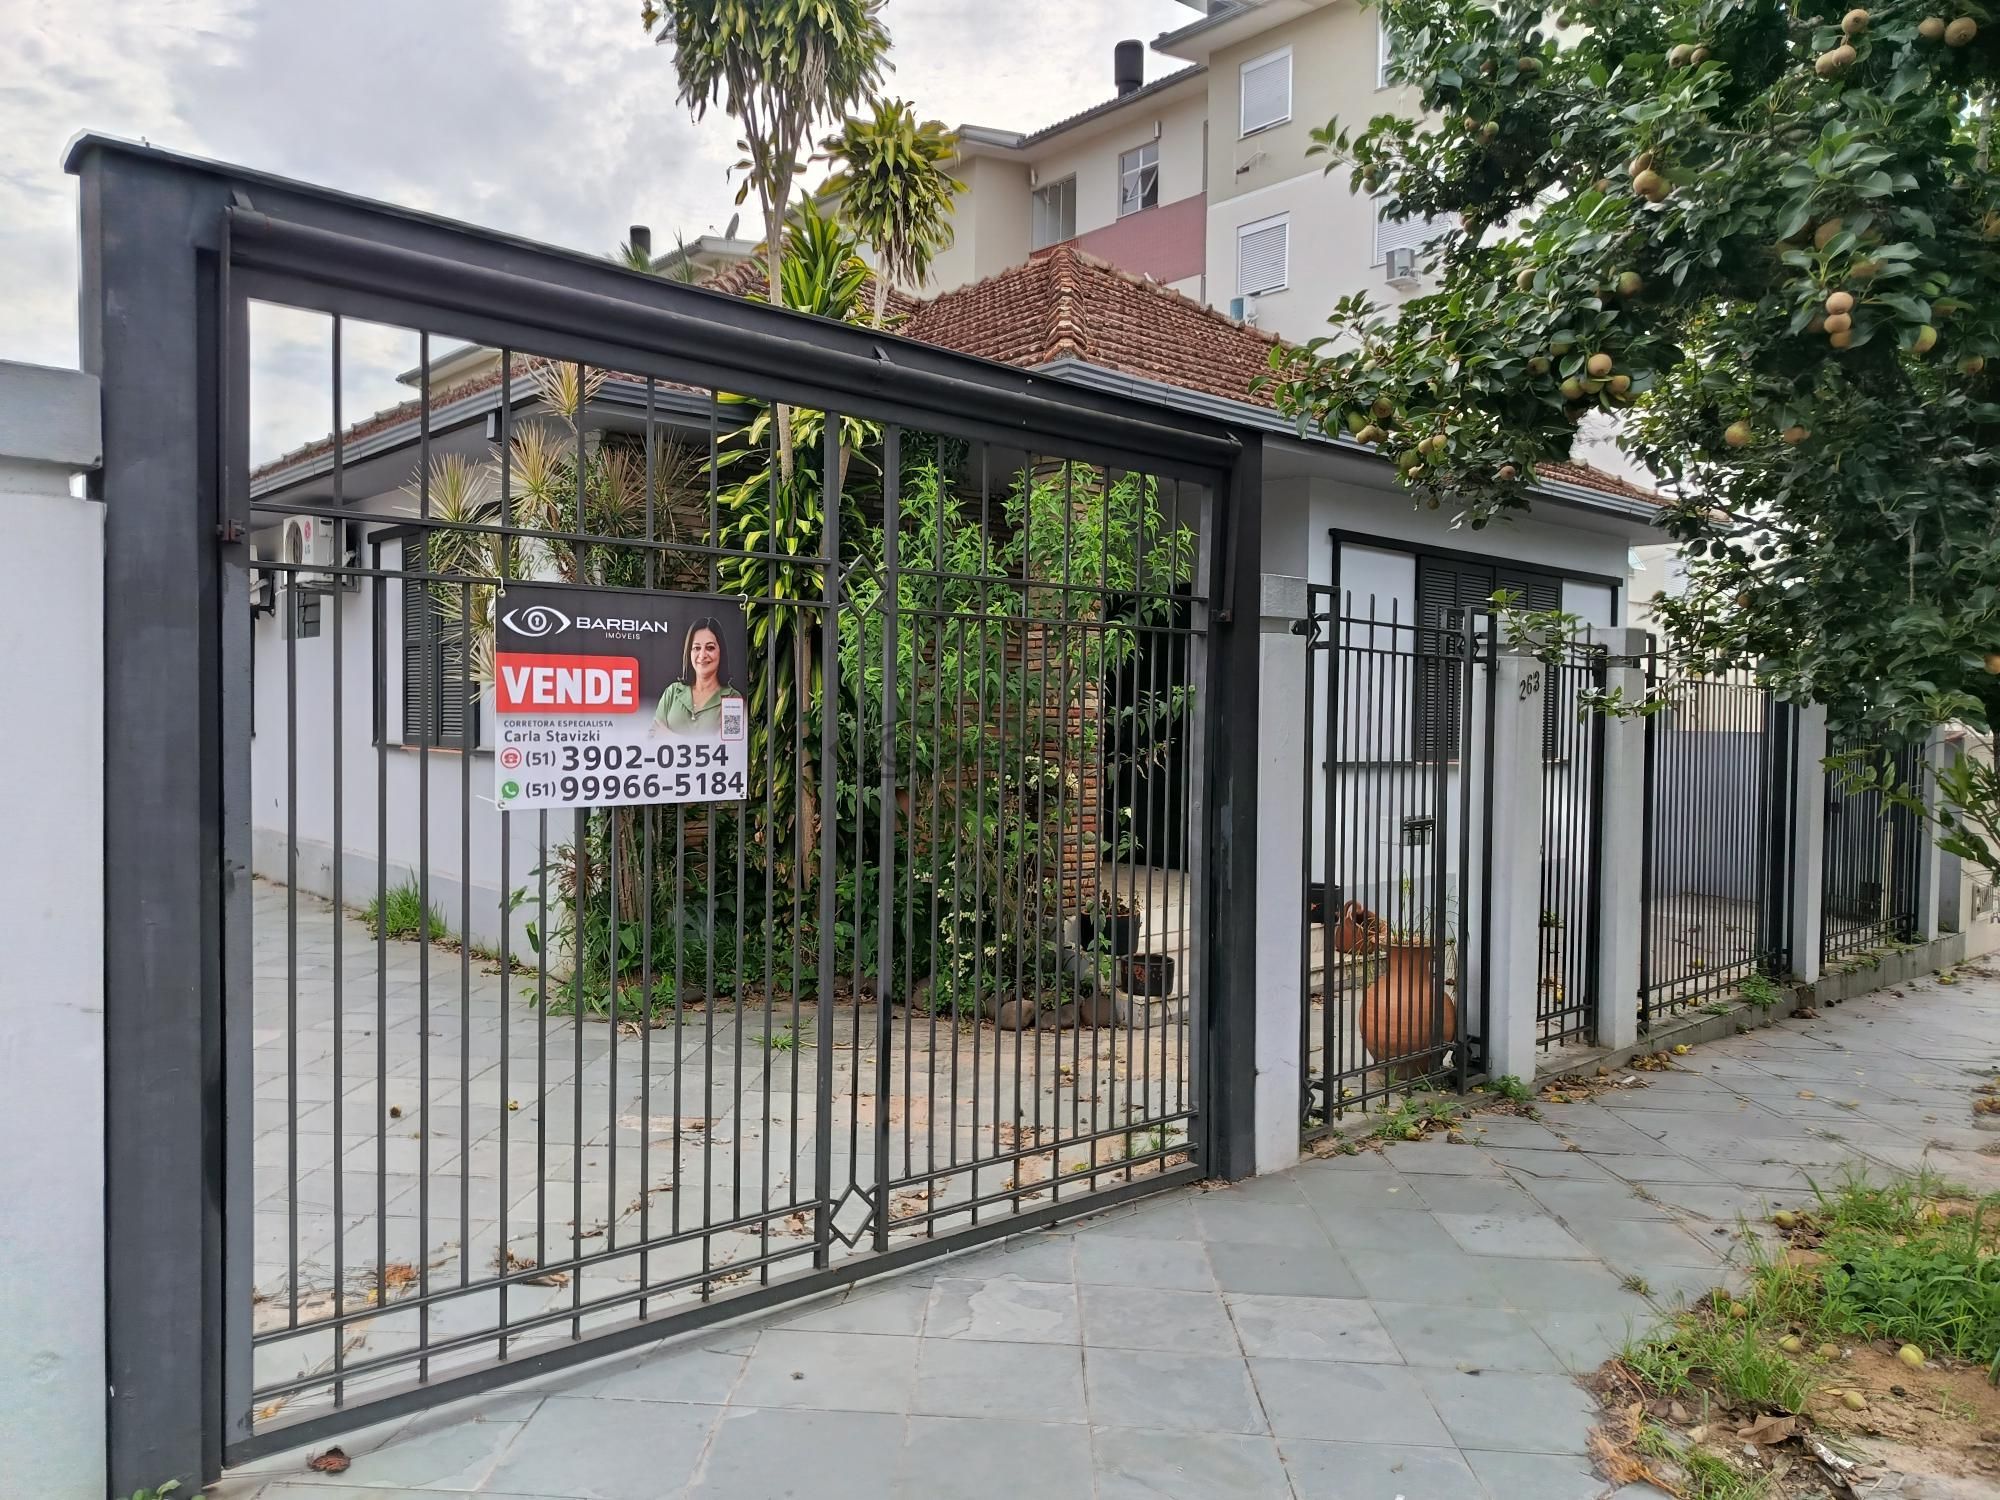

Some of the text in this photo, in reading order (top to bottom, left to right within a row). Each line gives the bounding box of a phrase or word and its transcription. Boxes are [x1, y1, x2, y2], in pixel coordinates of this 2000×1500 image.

[576, 616, 668, 633] BARBIAN
[605, 631, 641, 640] IMÓVEIS
[502, 666, 633, 705] VENDE
[1520, 671, 1540, 701] 263
[503, 720, 614, 728] CORRETORA ESPECIALISTA
[504, 729, 600, 743] Carla Stavizki
[526, 744, 729, 771] (51) 3902-0354
[526, 771, 744, 802] (51) 99966-5184
